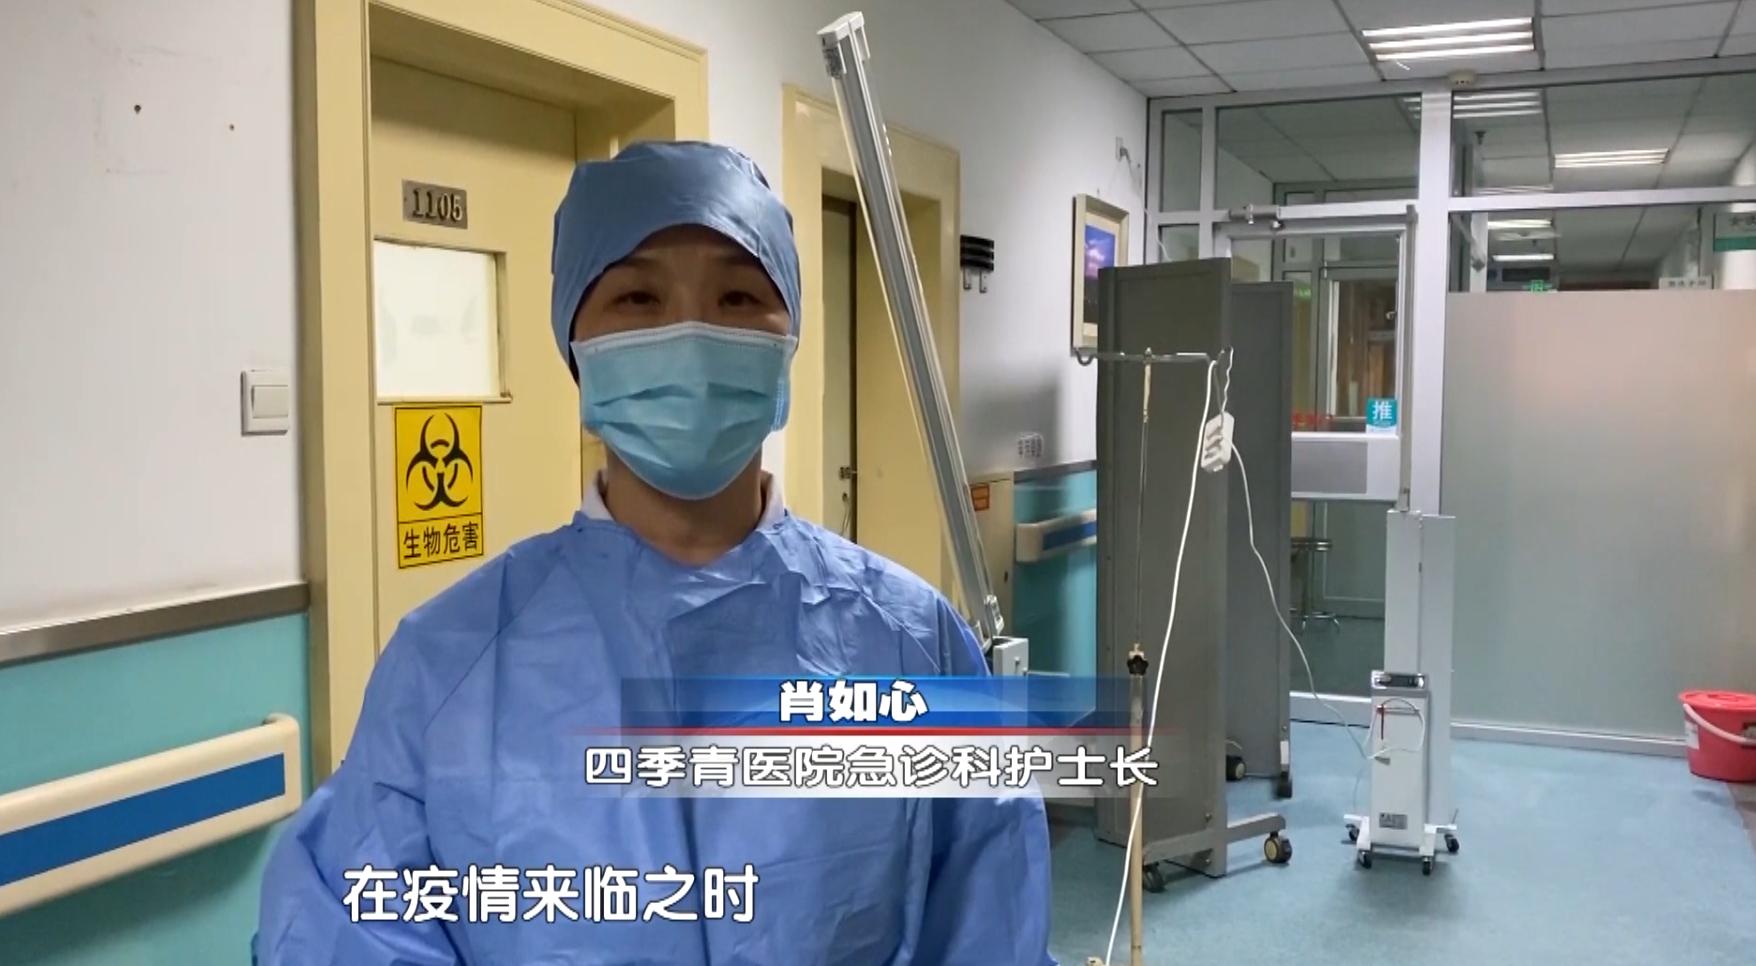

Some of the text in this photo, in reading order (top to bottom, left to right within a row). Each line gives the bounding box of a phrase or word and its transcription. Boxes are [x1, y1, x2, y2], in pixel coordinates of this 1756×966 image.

[412, 187, 463, 222] 1105
[1372, 400, 1393, 420] 推
[403, 521, 479, 559] 生物危害
